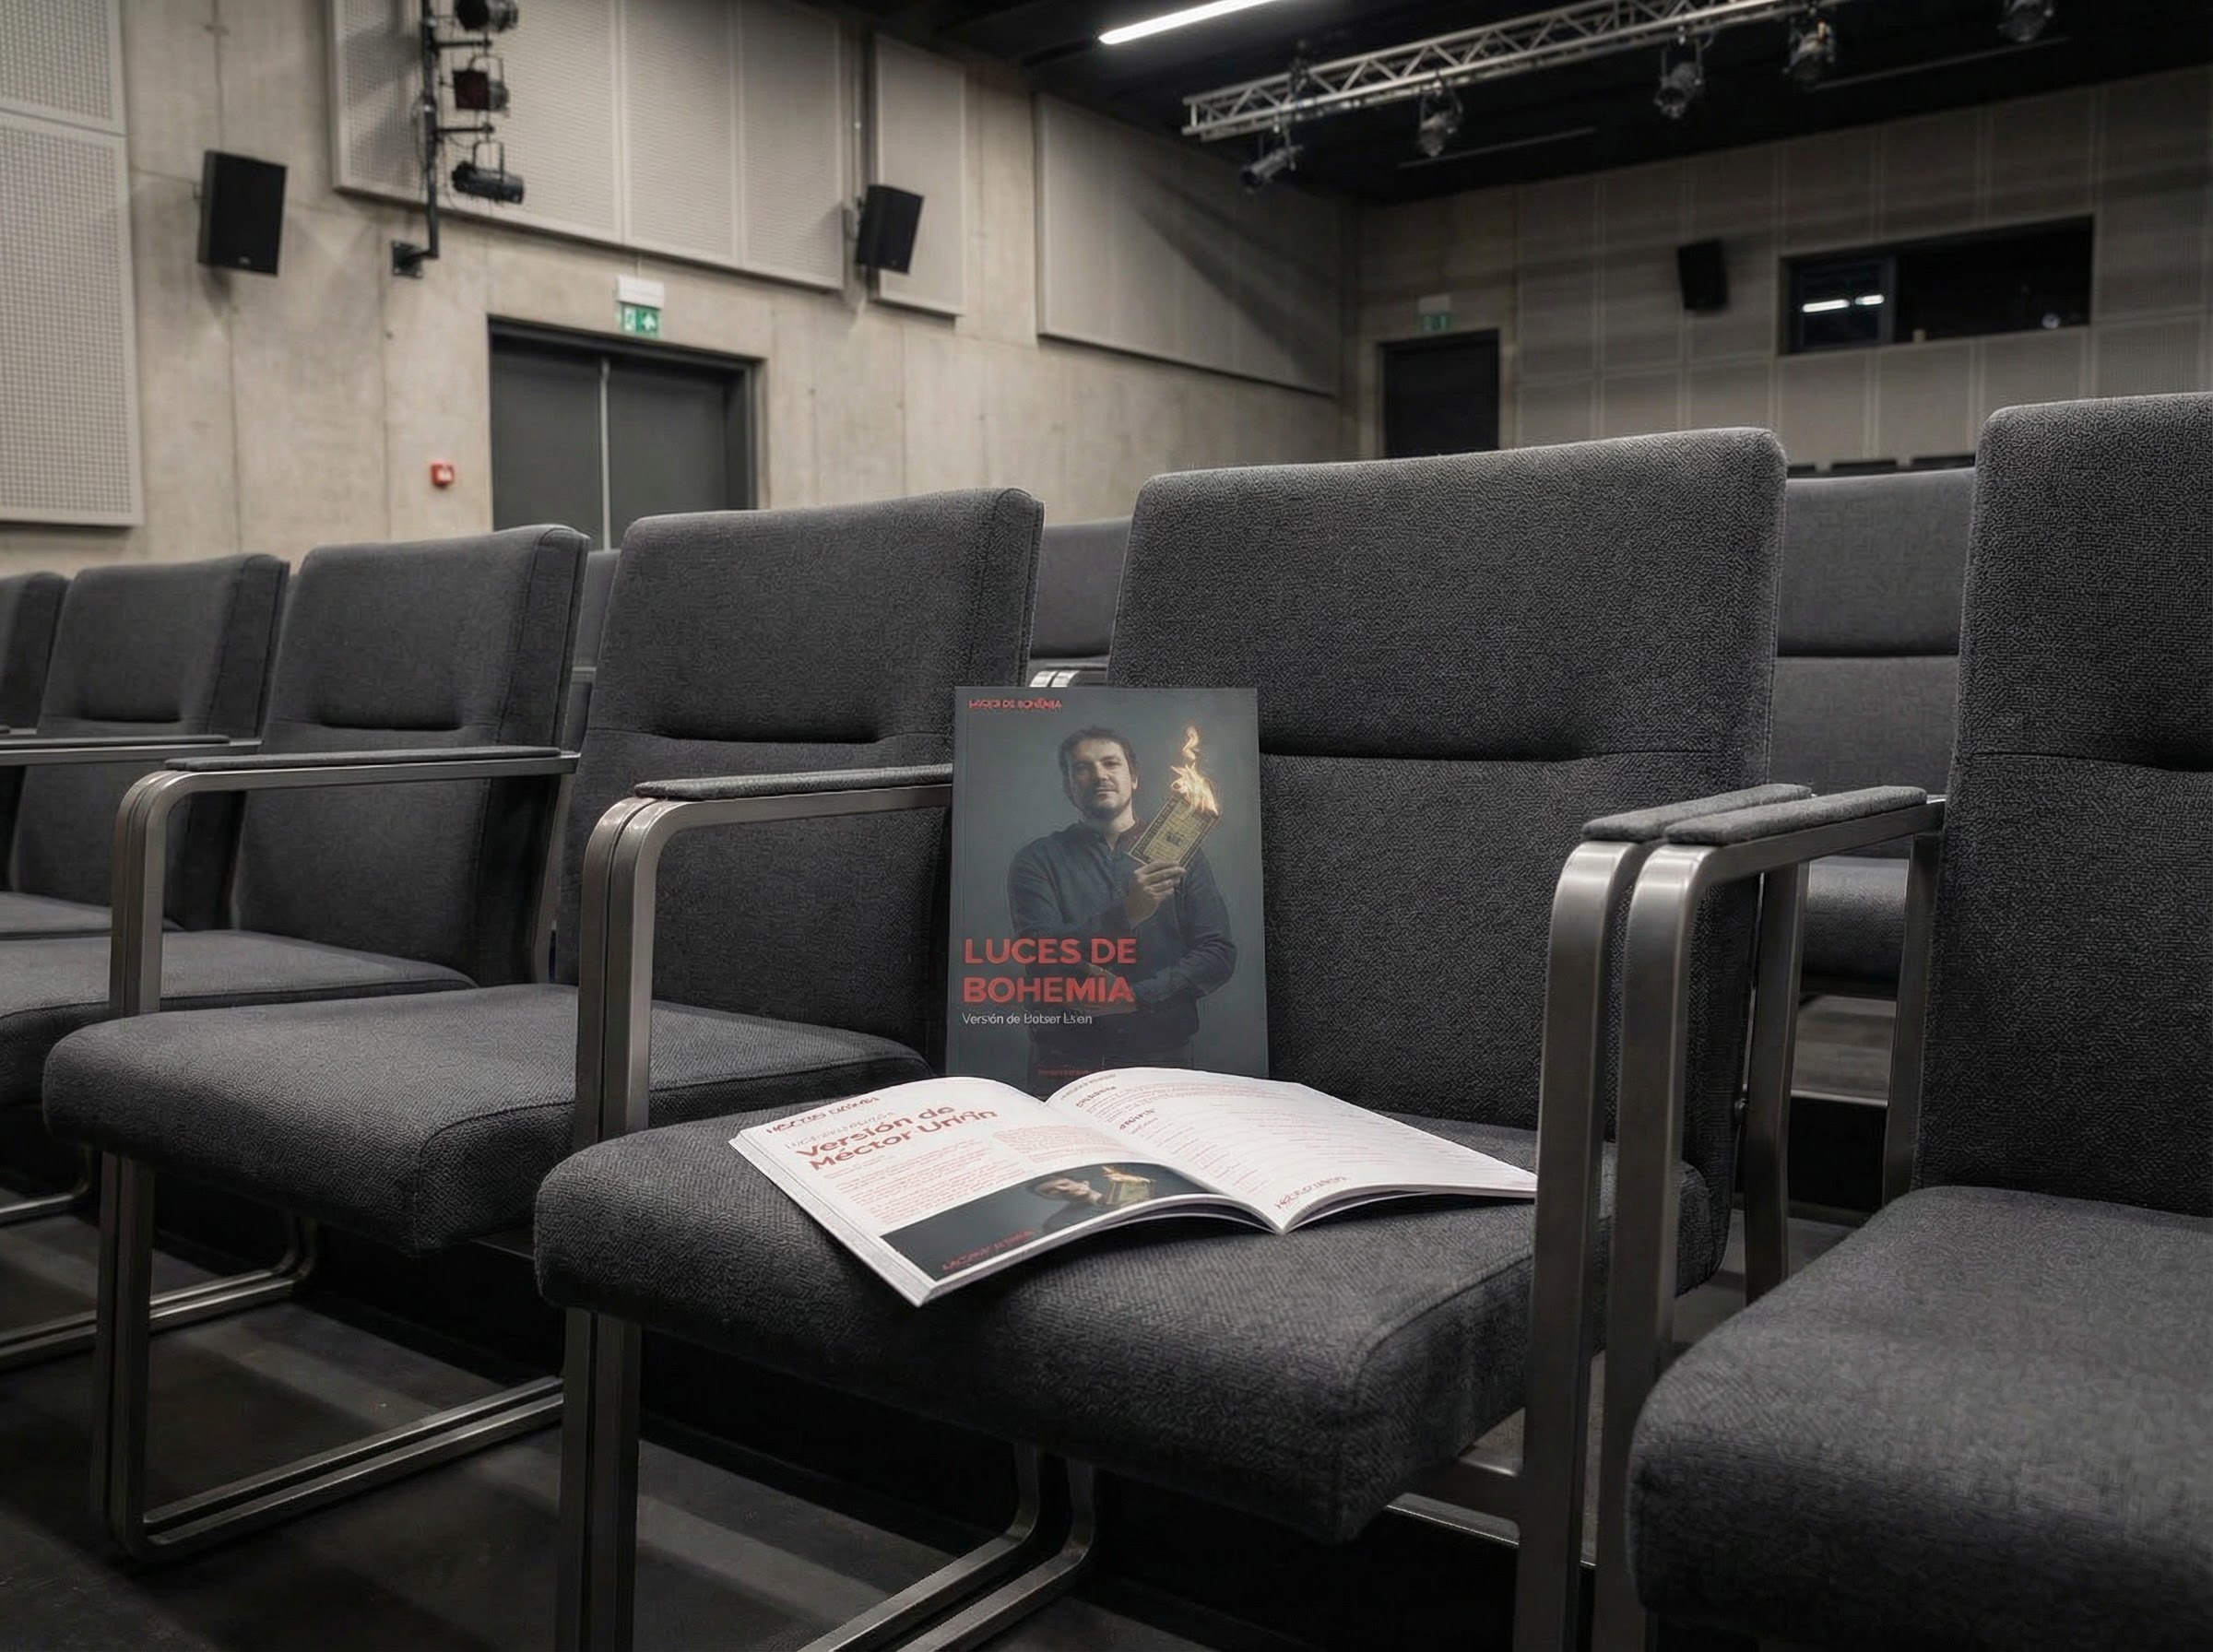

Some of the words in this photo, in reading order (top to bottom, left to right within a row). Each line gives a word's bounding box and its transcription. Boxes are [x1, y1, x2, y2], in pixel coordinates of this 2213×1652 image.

[964, 938, 1082, 964] LUCES
[1091, 938, 1137, 964] DE
[964, 976, 1135, 1003] BOHEMIA
[1006, 1012, 1021, 1024] de
[796, 1116, 914, 1157] Versión
[918, 1106, 955, 1120] de
